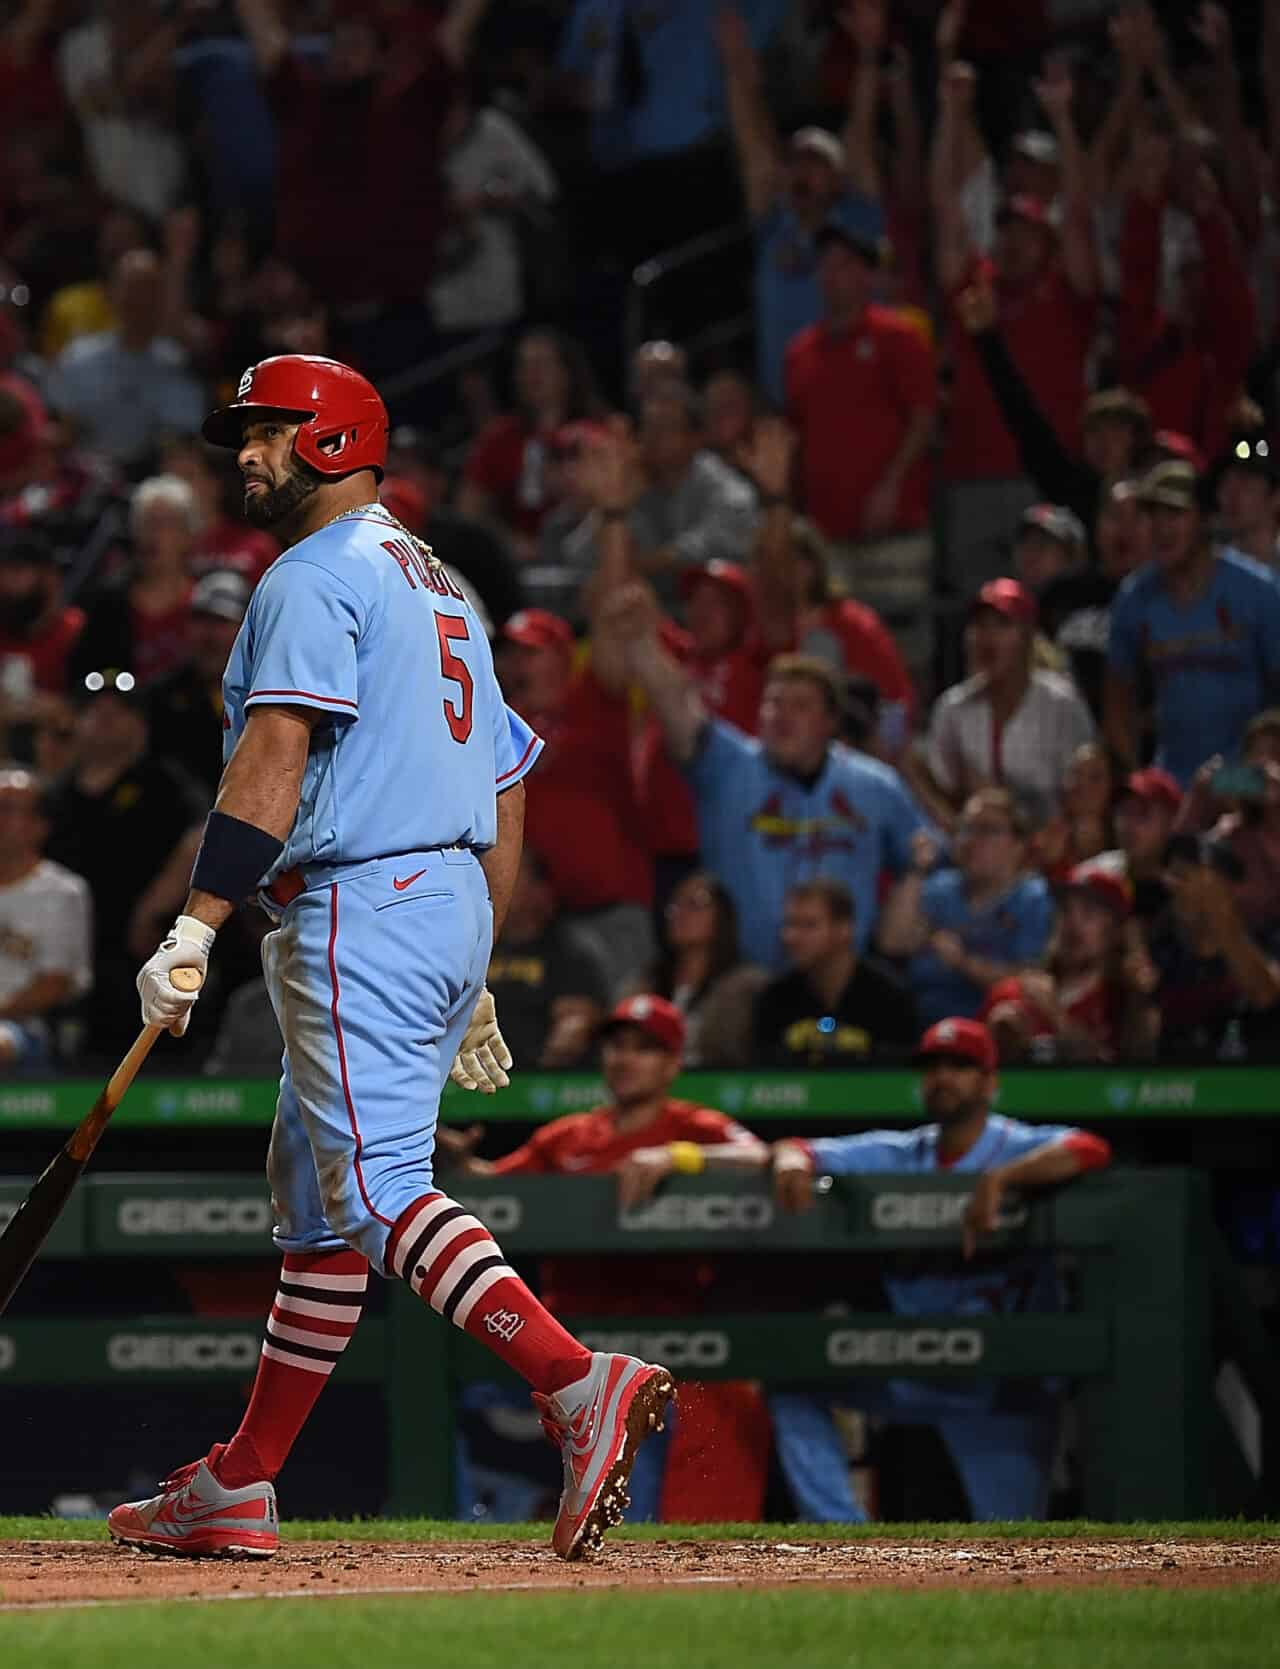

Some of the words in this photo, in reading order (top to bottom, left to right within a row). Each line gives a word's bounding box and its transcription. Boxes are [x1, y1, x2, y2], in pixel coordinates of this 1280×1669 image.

[433, 609, 473, 745] 5
[118, 1198, 270, 1235] GEICO
[107, 1333, 260, 1370] GEICO
[826, 1329, 984, 1365] GEICO
